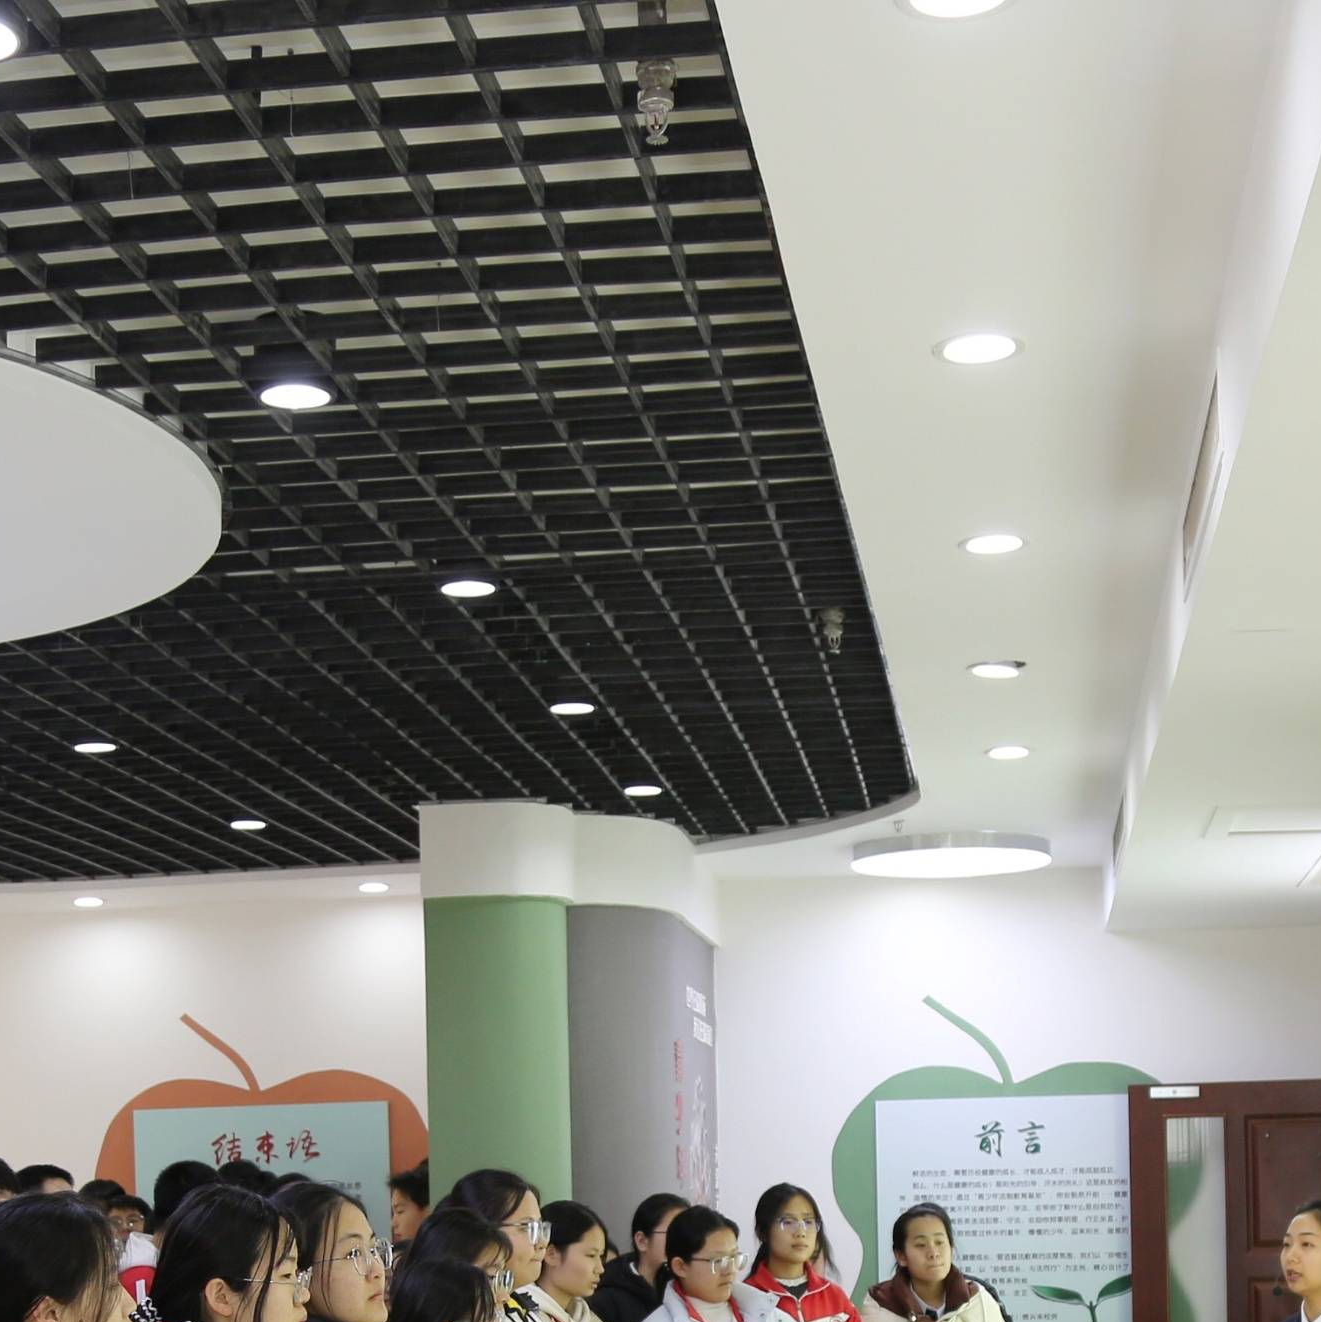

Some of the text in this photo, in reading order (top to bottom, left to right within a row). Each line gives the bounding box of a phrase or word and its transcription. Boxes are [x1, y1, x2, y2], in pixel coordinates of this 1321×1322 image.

[211, 1129, 320, 1165] 结束语
[974, 1121, 1045, 1159] 前言
